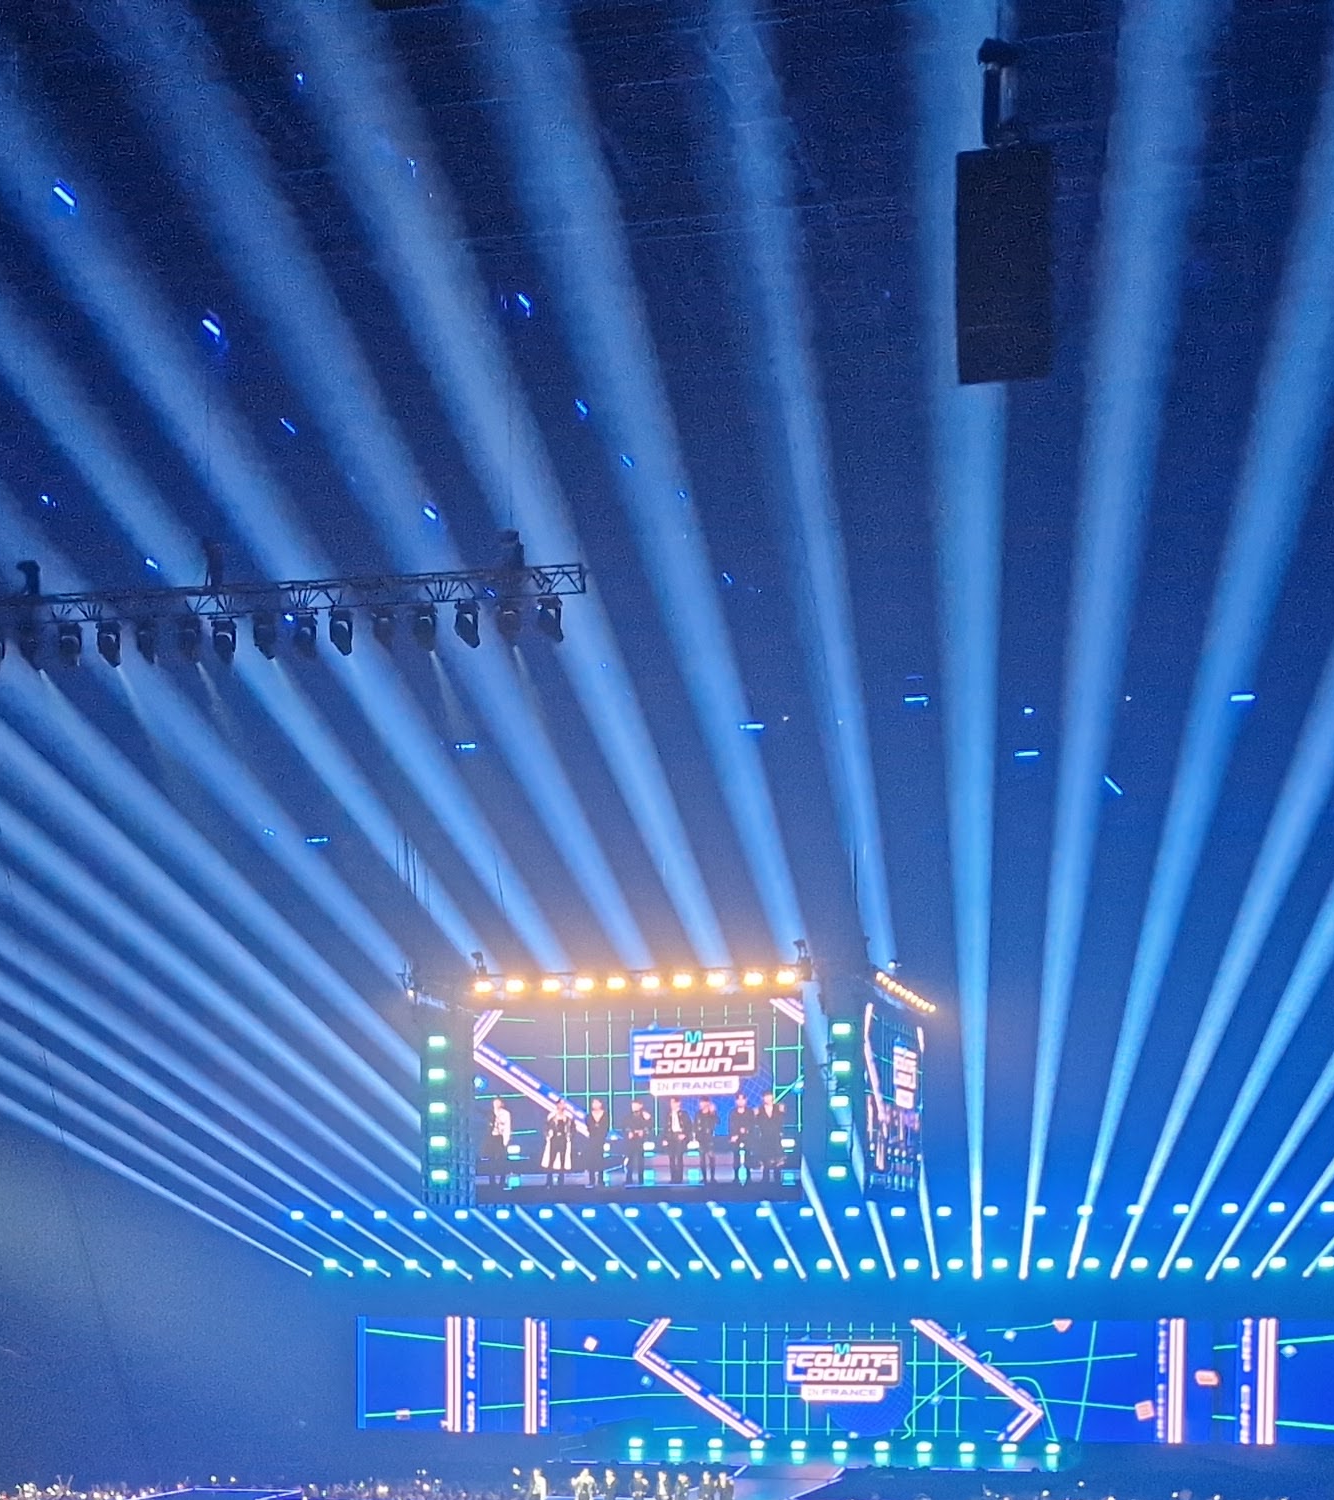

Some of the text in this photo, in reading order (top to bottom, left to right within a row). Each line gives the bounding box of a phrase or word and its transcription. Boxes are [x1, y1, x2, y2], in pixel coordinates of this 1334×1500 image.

[684, 1030, 703, 1043] M
[643, 1039, 744, 1059] COUNT
[654, 1057, 733, 1074] DOWN
[672, 1080, 733, 1090] FRANCE
[834, 1343, 851, 1355] M
[796, 1353, 888, 1368] COUNT
[806, 1368, 878, 1382] DOWN
[821, 1388, 877, 1397] FRANCE
